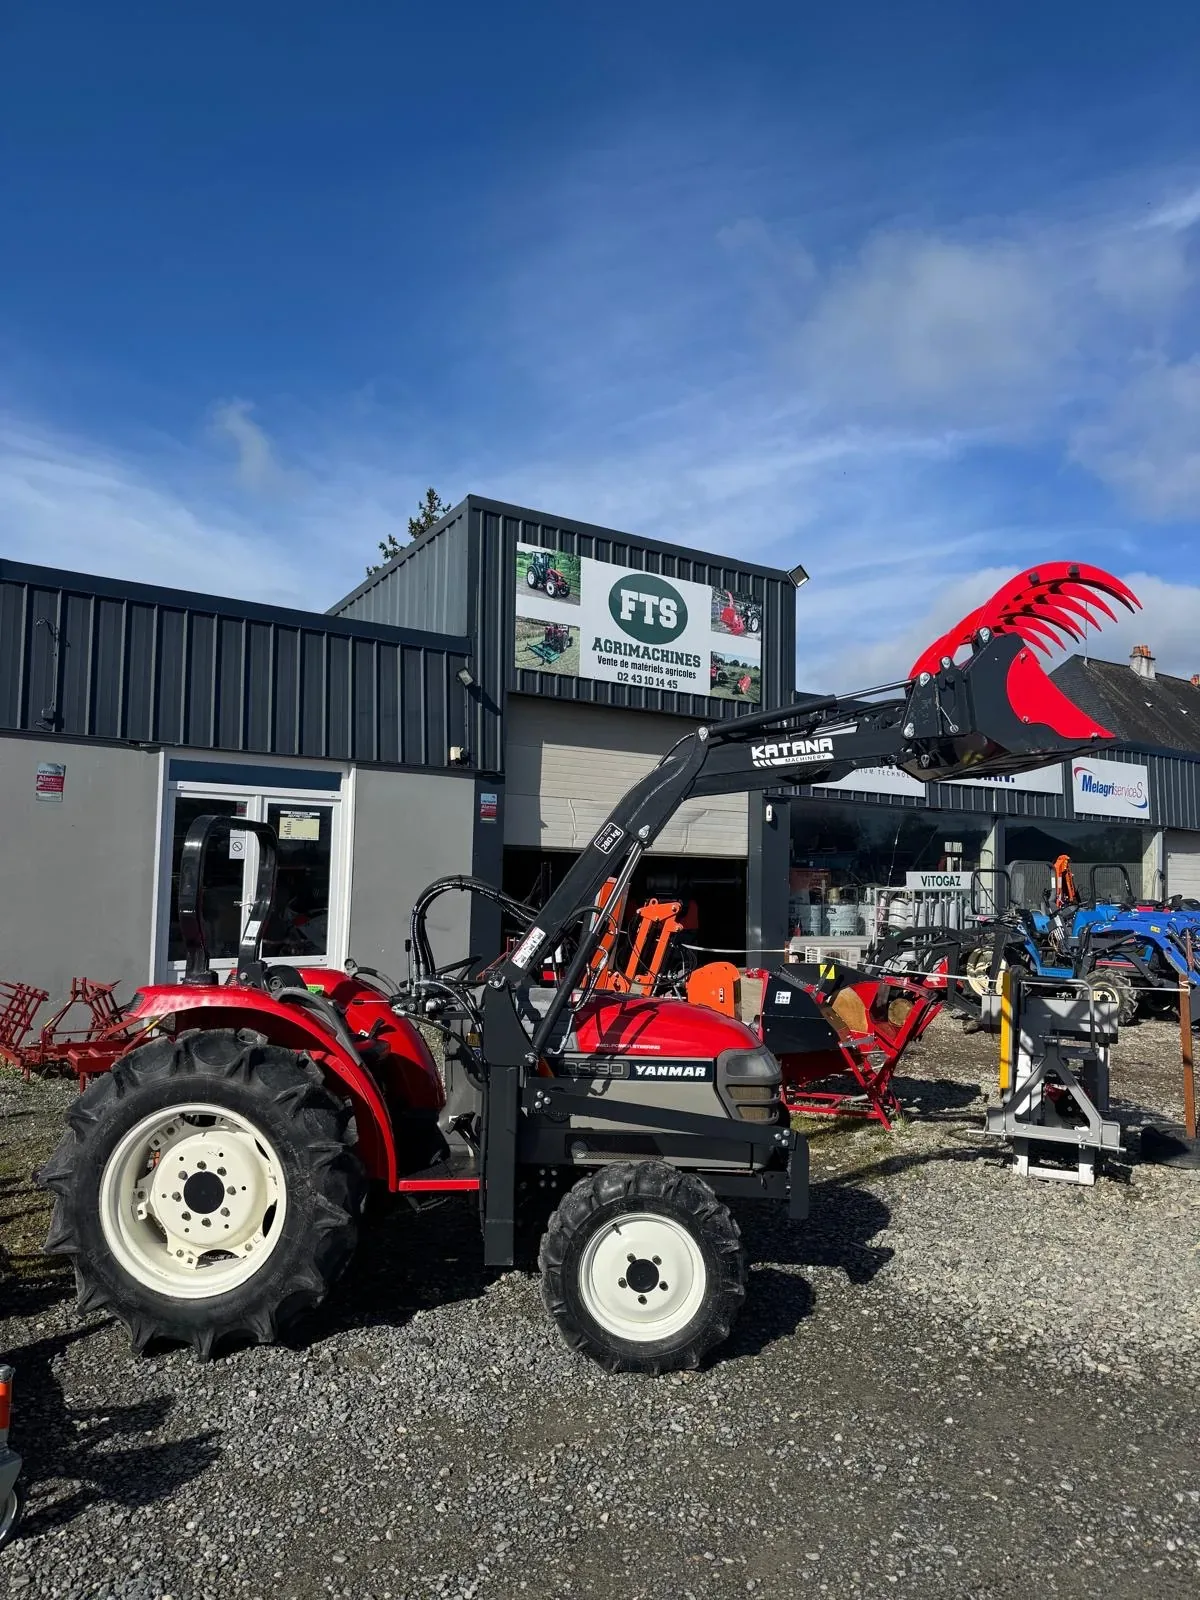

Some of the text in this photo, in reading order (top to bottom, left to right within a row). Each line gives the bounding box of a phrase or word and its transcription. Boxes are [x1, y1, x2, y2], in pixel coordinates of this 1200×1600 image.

[620, 589, 678, 629] FTS
[592, 637, 701, 668] AGRIMACHINES
[597, 655, 697, 679] Vente de matériels agricoles
[617, 671, 678, 689] 02 43 10 14 45
[751, 737, 833, 760] KATANA
[635, 1065, 706, 1077] YANMAR
